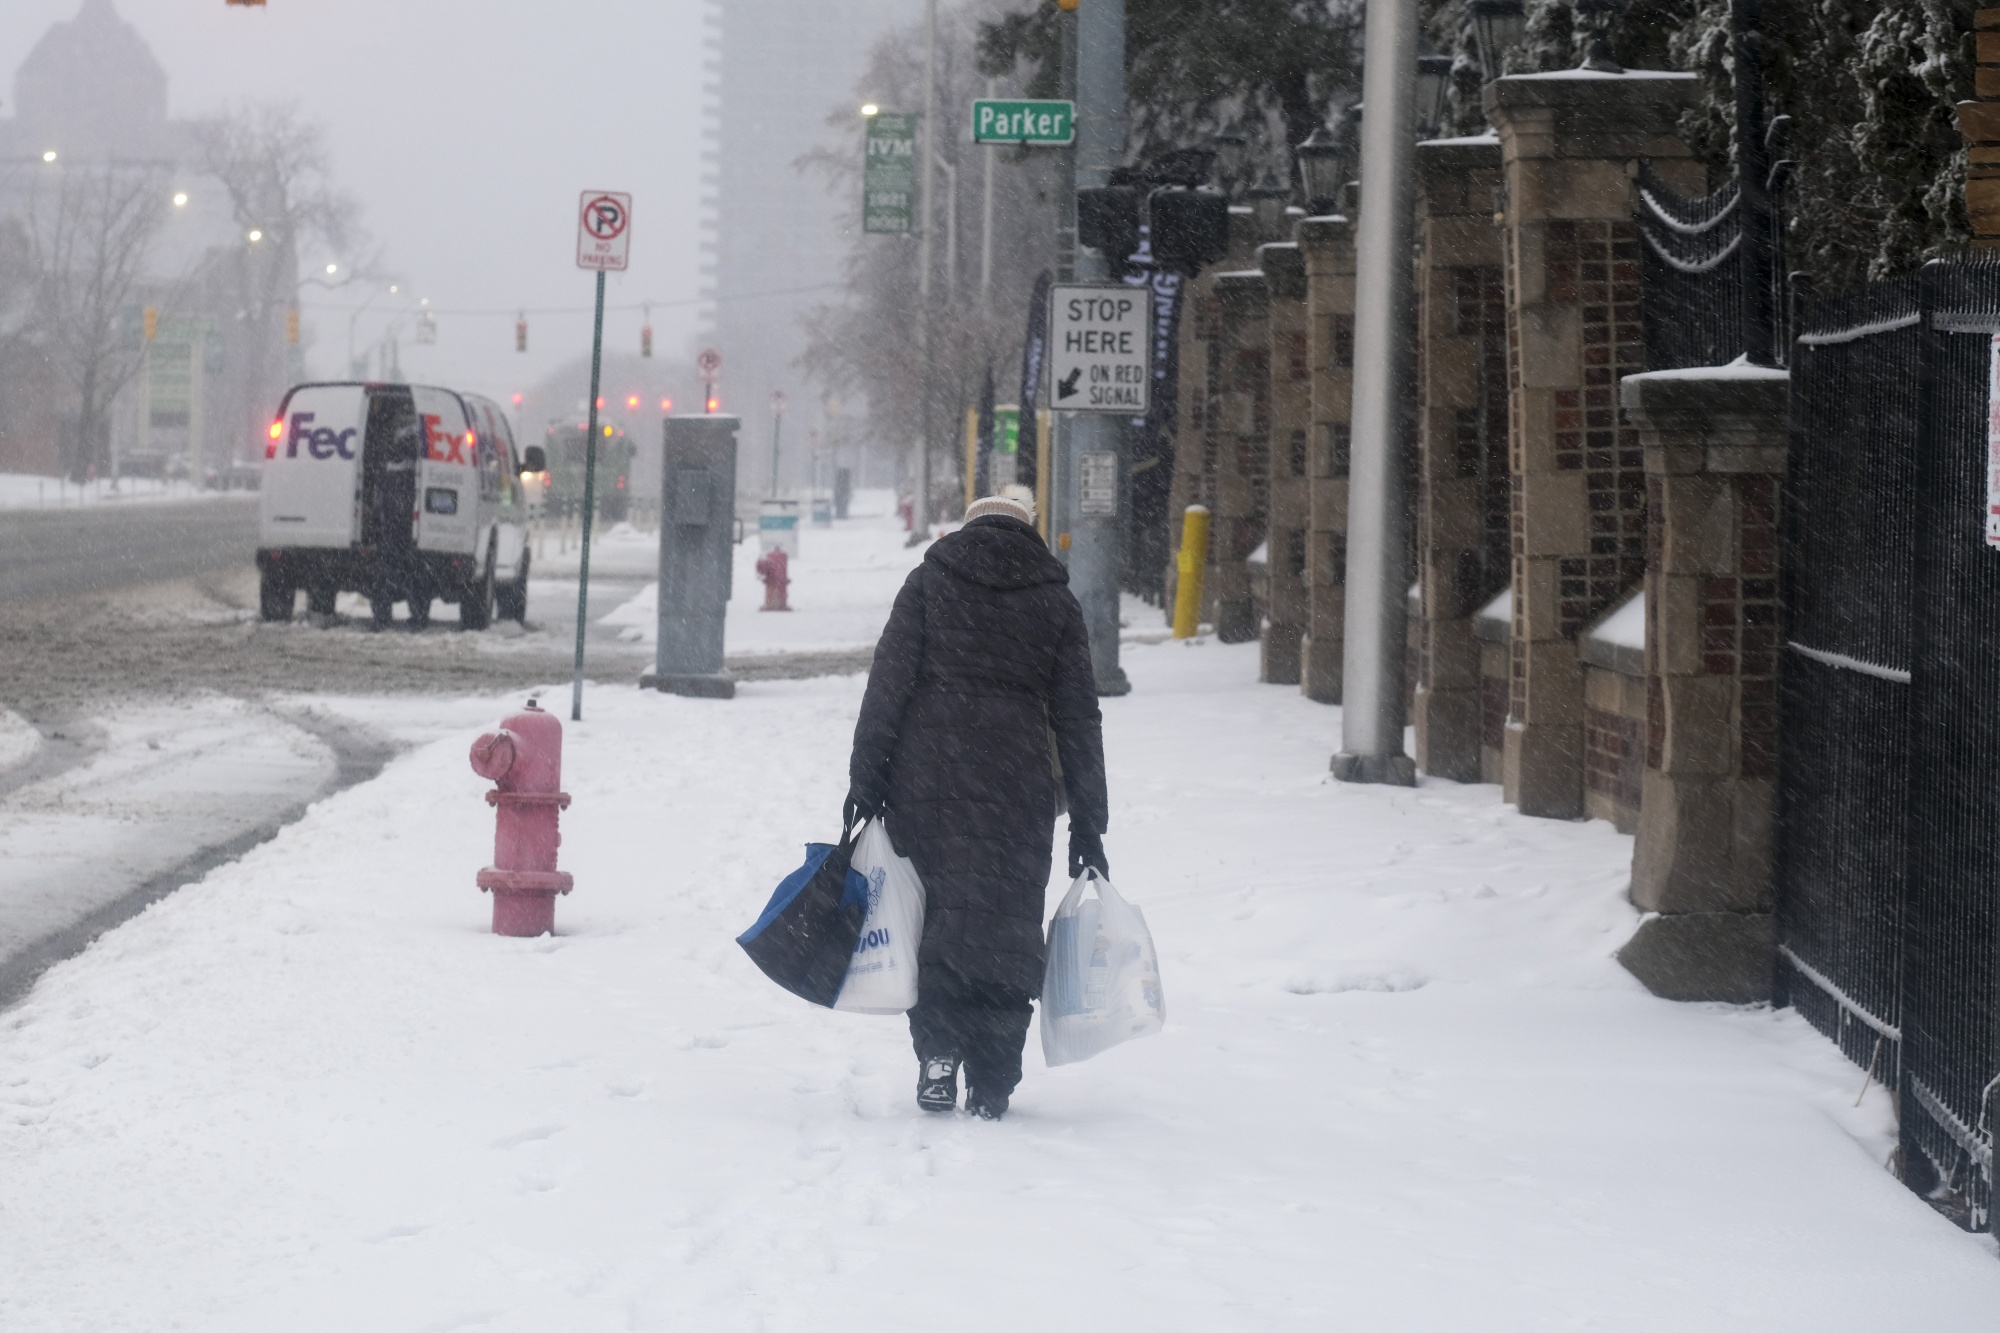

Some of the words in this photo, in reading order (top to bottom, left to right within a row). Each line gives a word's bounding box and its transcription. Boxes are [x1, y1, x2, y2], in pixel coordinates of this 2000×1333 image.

[980, 107, 1064, 135] Parker
[595, 242, 611, 254] NO
[1068, 299, 1132, 321] STOP
[1065, 330, 1133, 354] HERE
[1090, 364, 1110, 383] ON
[1115, 364, 1143, 384] RED
[1089, 385, 1142, 405] SIGNAL
